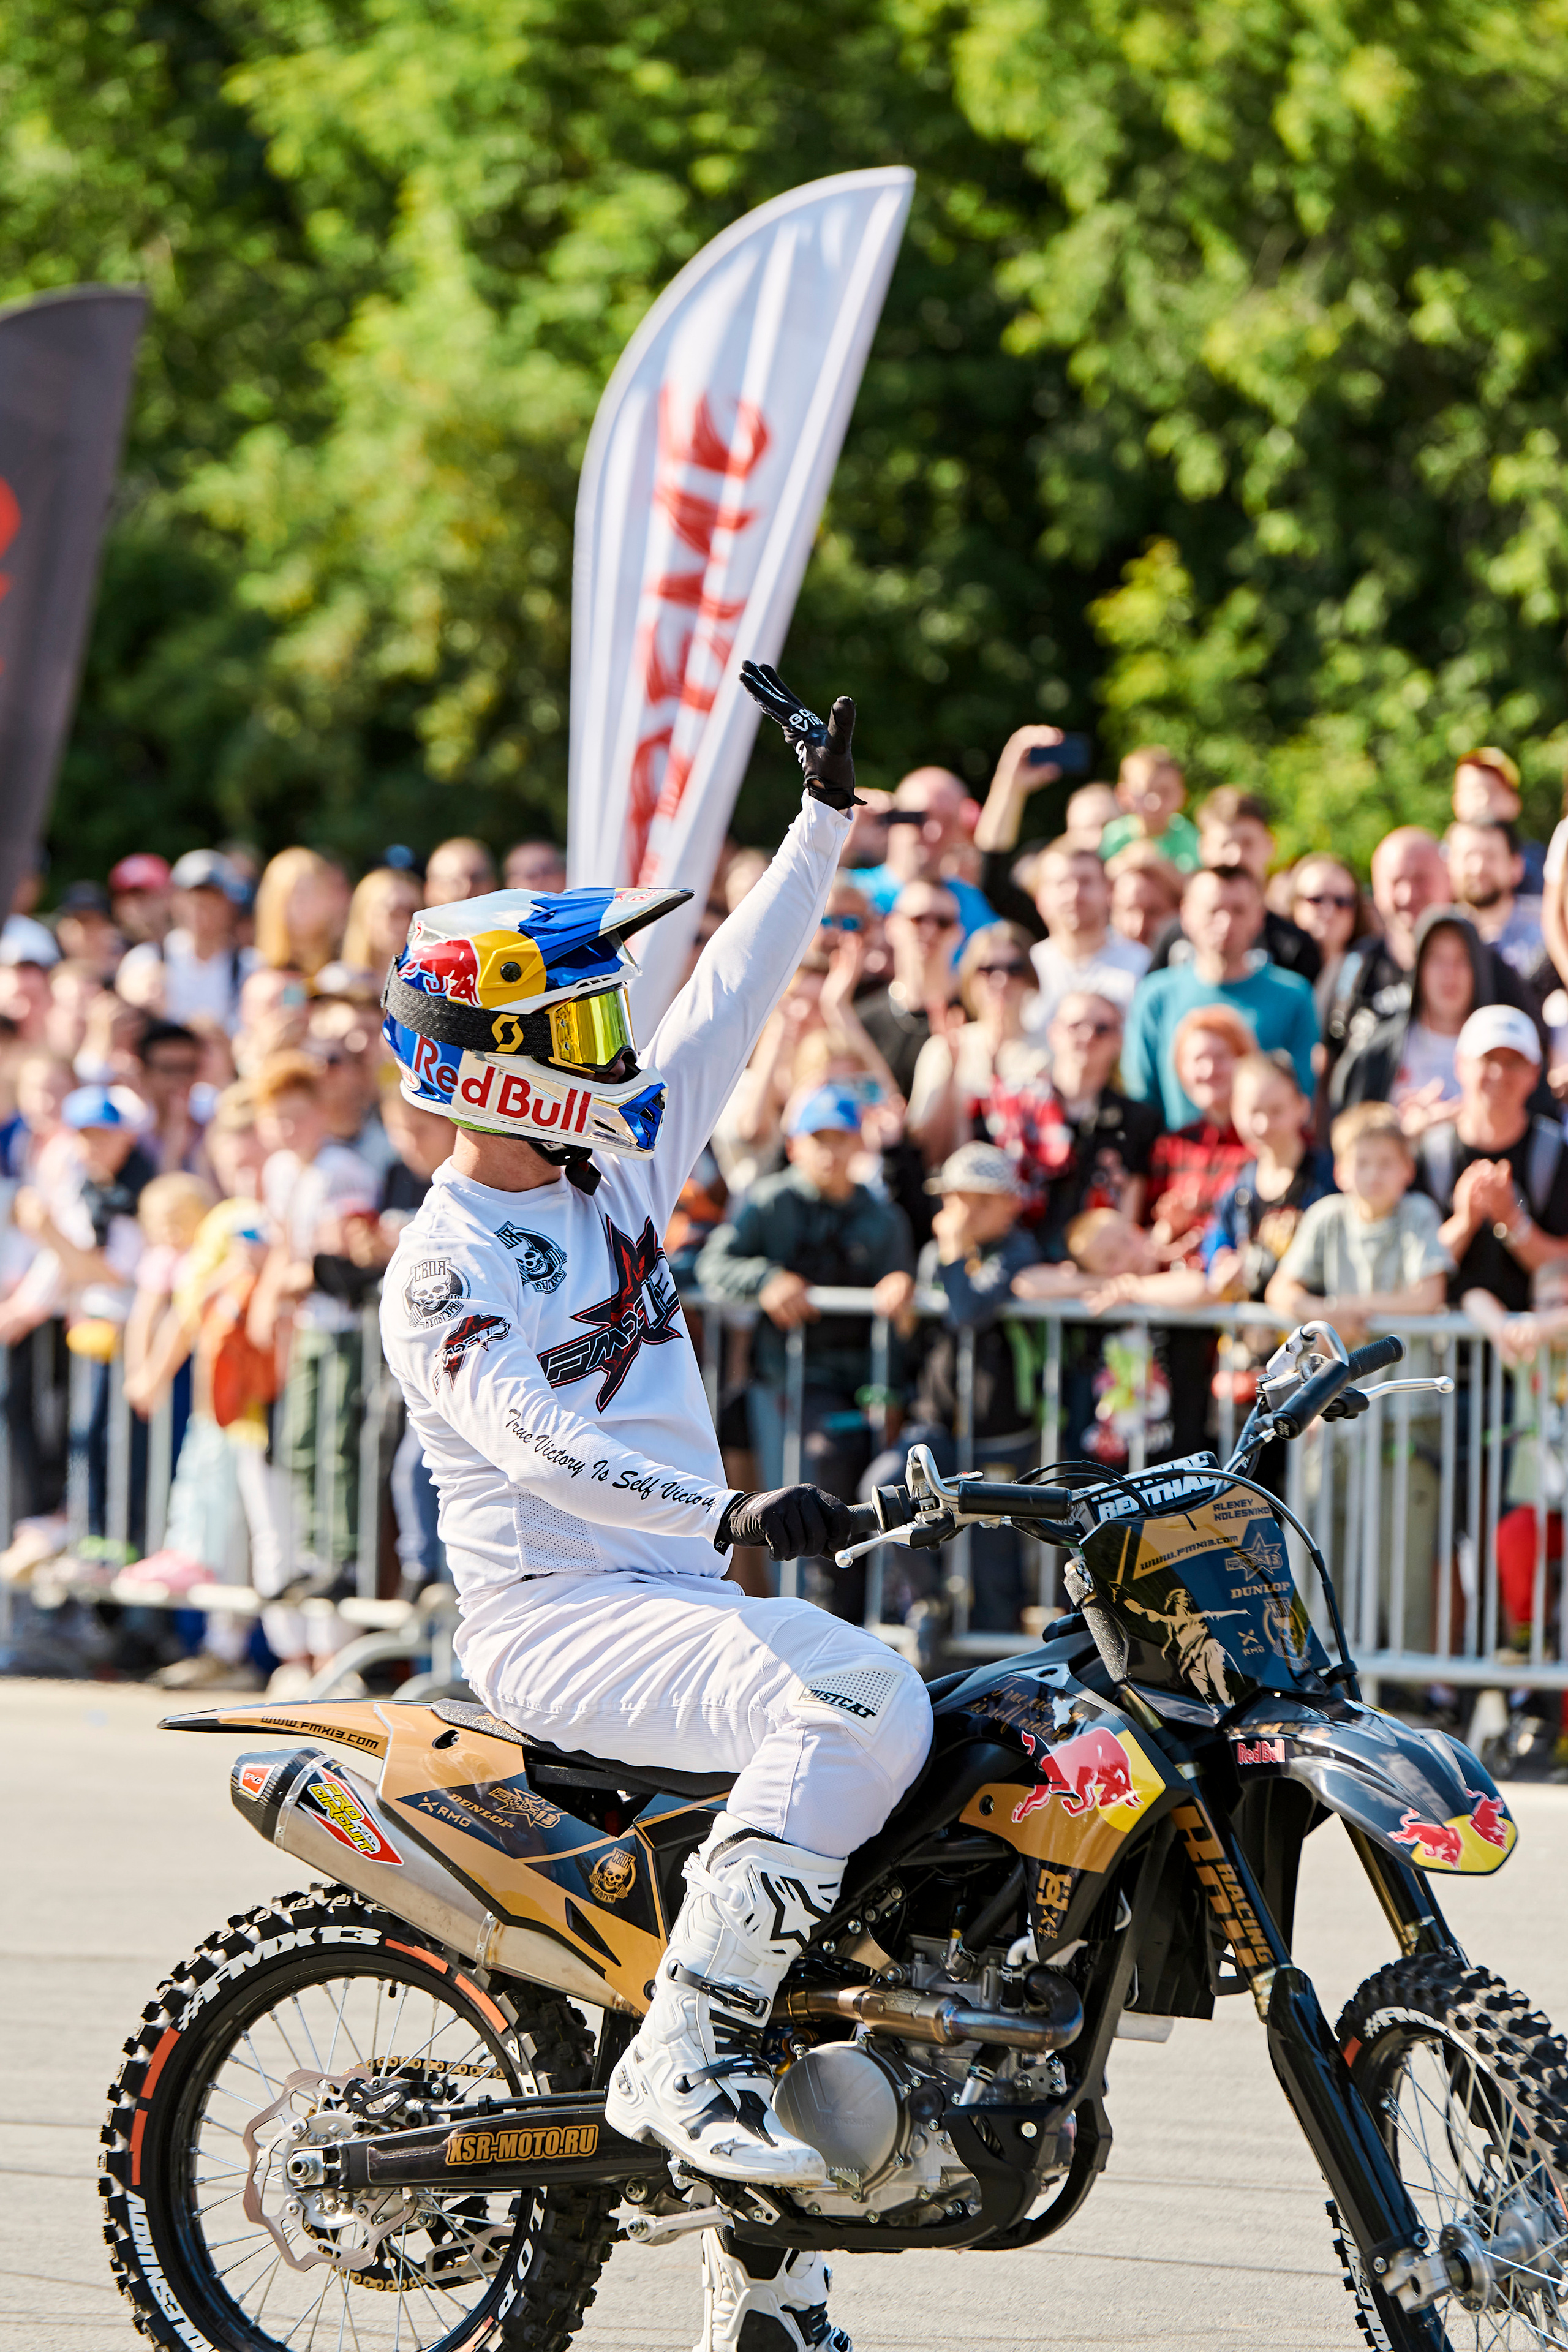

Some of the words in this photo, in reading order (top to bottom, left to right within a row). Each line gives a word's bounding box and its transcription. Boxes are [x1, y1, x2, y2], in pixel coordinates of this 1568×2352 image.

[414, 1035, 496, 1109] Red
[497, 1074, 592, 1133] Bull
[505, 1409, 533, 1443] True
[535, 1434, 586, 1478] Victory
[590, 1460, 608, 1482] Is
[612, 1471, 660, 1501] Self
[1212, 1499, 1253, 1512] ALEXEY
[1214, 1506, 1273, 1521] KOLESNIKO
[1230, 1581, 1291, 1599] DUNLOP
[1242, 1645, 1266, 1657] RMG
[1237, 1740, 1261, 1765] Red
[310, 1785, 375, 1852] CIRCUIT
[323, 1784, 363, 1820] PRO
[437, 1806, 472, 1828] RMG
[447, 1793, 515, 1828] DUNLOP
[1216, 1864, 1276, 1964] RACING
[178, 1926, 383, 2032] #FMX13
[447, 2126, 597, 2164] XSR-MOTO.RU
